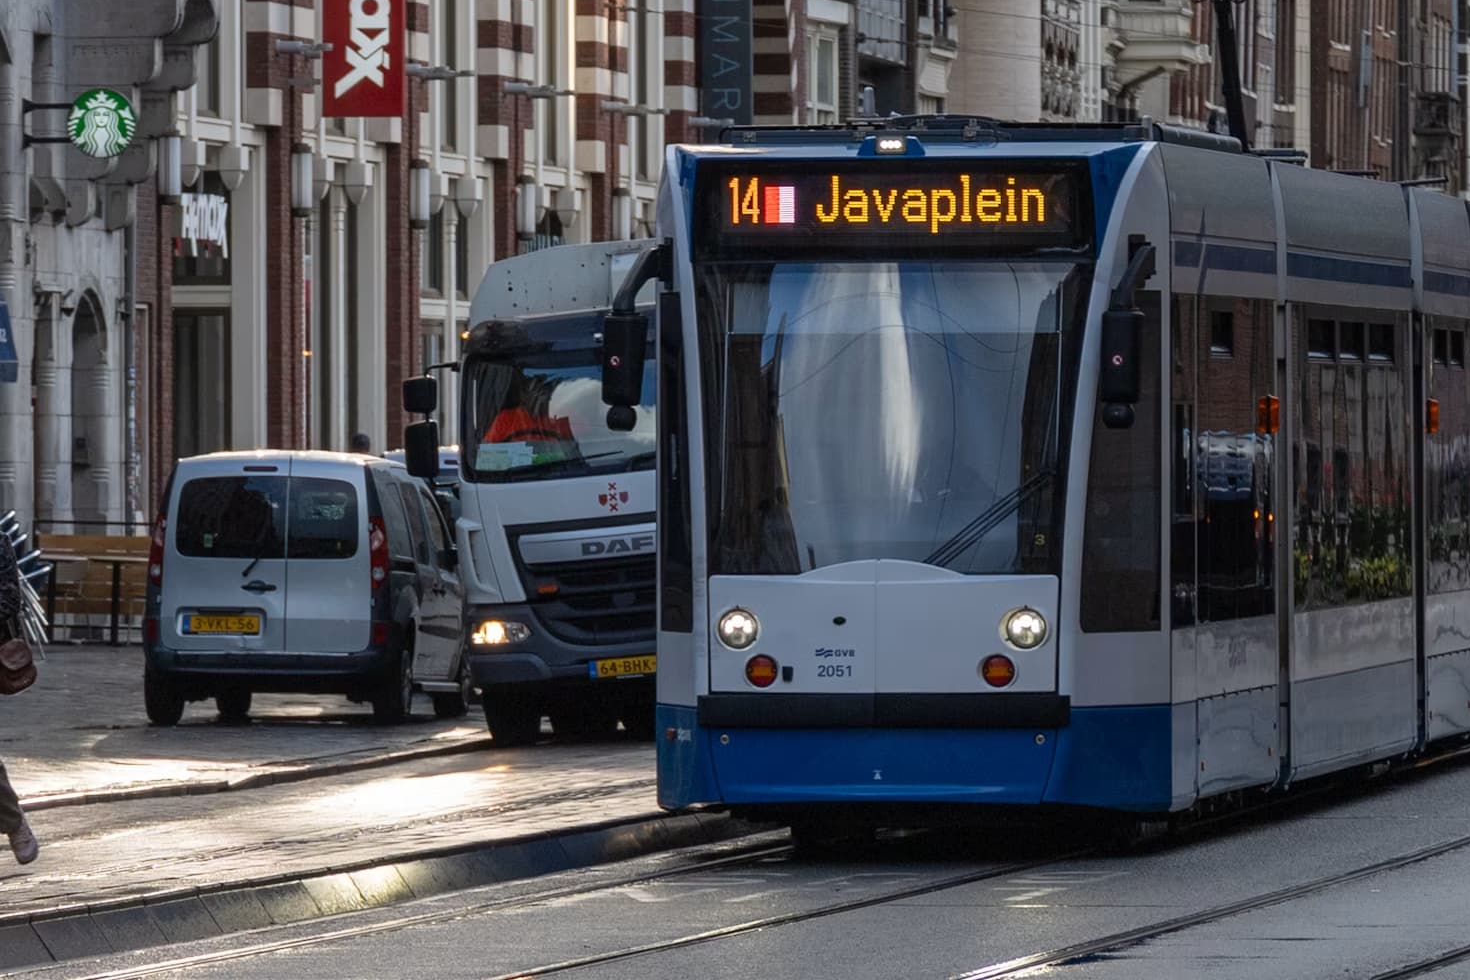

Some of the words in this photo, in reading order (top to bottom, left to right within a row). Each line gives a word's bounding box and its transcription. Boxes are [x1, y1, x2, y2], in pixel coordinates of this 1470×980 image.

[729, 177, 760, 223] 14
[816, 175, 1045, 234] Javaplein
[581, 535, 654, 557] DAF
[1034, 533, 1046, 546] 3
[817, 664, 852, 677] 2051
